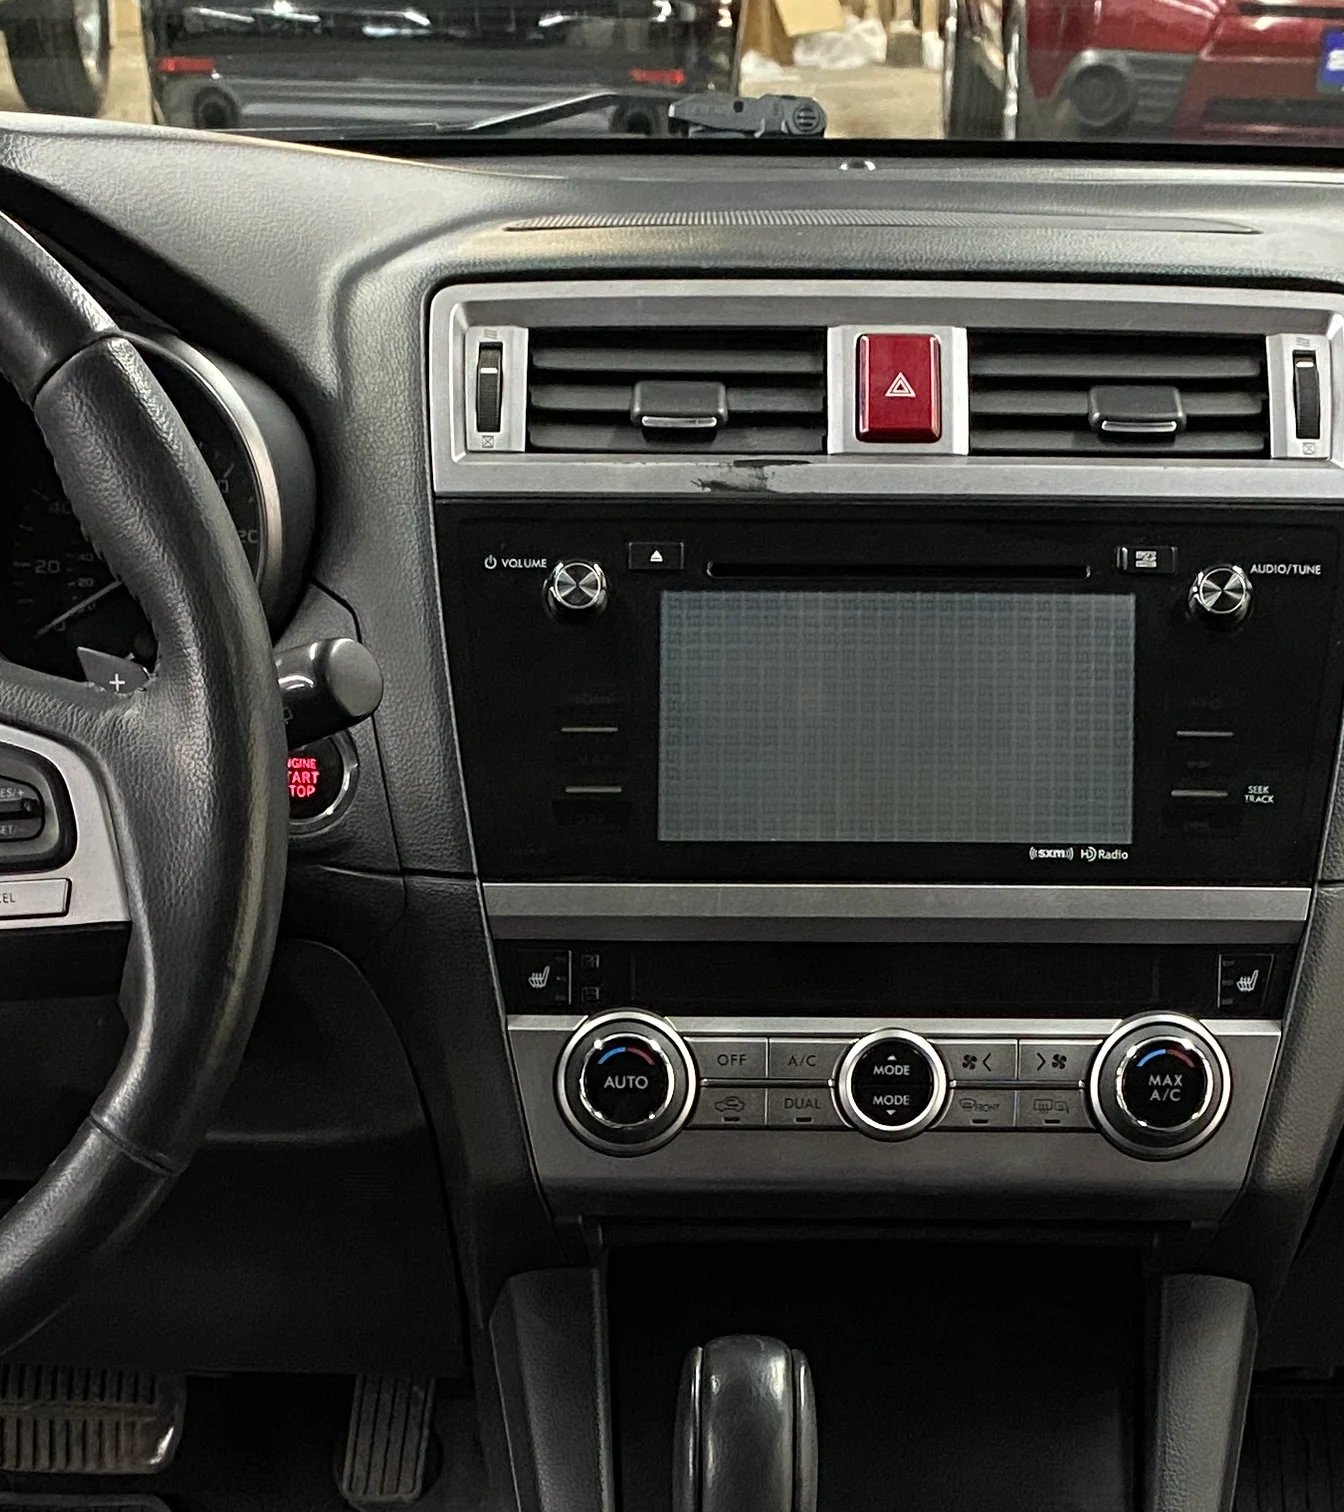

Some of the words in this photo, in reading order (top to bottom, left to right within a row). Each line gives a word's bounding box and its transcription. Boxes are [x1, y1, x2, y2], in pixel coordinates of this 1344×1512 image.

[34, 560, 60, 575] 20
[501, 558, 547, 569] VOLUME
[1249, 564, 1322, 576] AUDIO/TUNE
[288, 784, 316, 798] TOP
[1248, 785, 1270, 795] SEEK
[1244, 794, 1275, 804] TRACK
[1098, 849, 1129, 860] Radio
[716, 1054, 748, 1067] OFF
[787, 1054, 817, 1068] A/C
[872, 1064, 911, 1076] MODE
[603, 1075, 649, 1090] AUTO
[1148, 1073, 1183, 1087] MAX
[872, 1094, 911, 1106] MODE
[1149, 1088, 1182, 1102] A/C
[783, 1096, 822, 1110] DUAL
